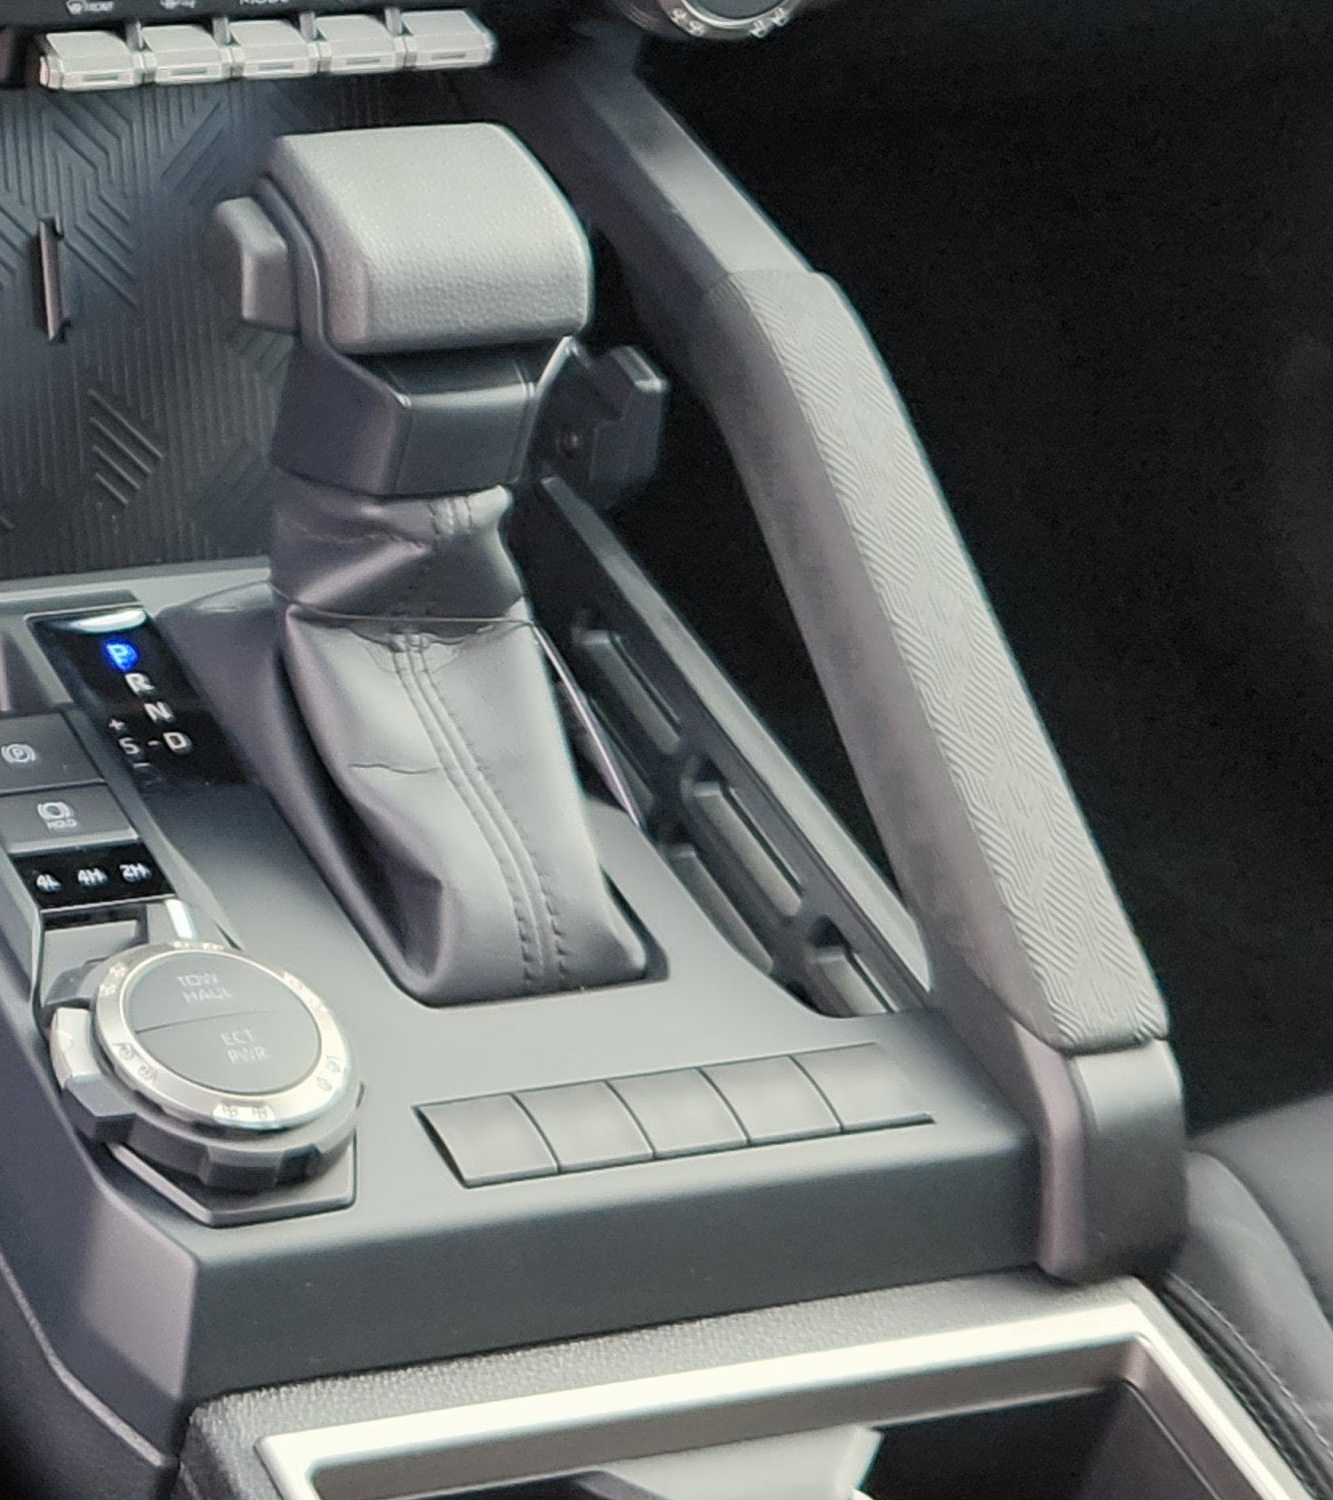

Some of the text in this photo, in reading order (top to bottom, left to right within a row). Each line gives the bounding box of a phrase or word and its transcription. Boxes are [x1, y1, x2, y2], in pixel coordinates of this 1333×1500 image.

[107, 641, 138, 671] P
[124, 672, 155, 695] R
[144, 701, 175, 723] N
[118, 736, 143, 757] S
[162, 731, 193, 754] D
[35, 873, 62, 893] 4L
[77, 867, 109, 888] 4H
[118, 863, 152, 883] 2H
